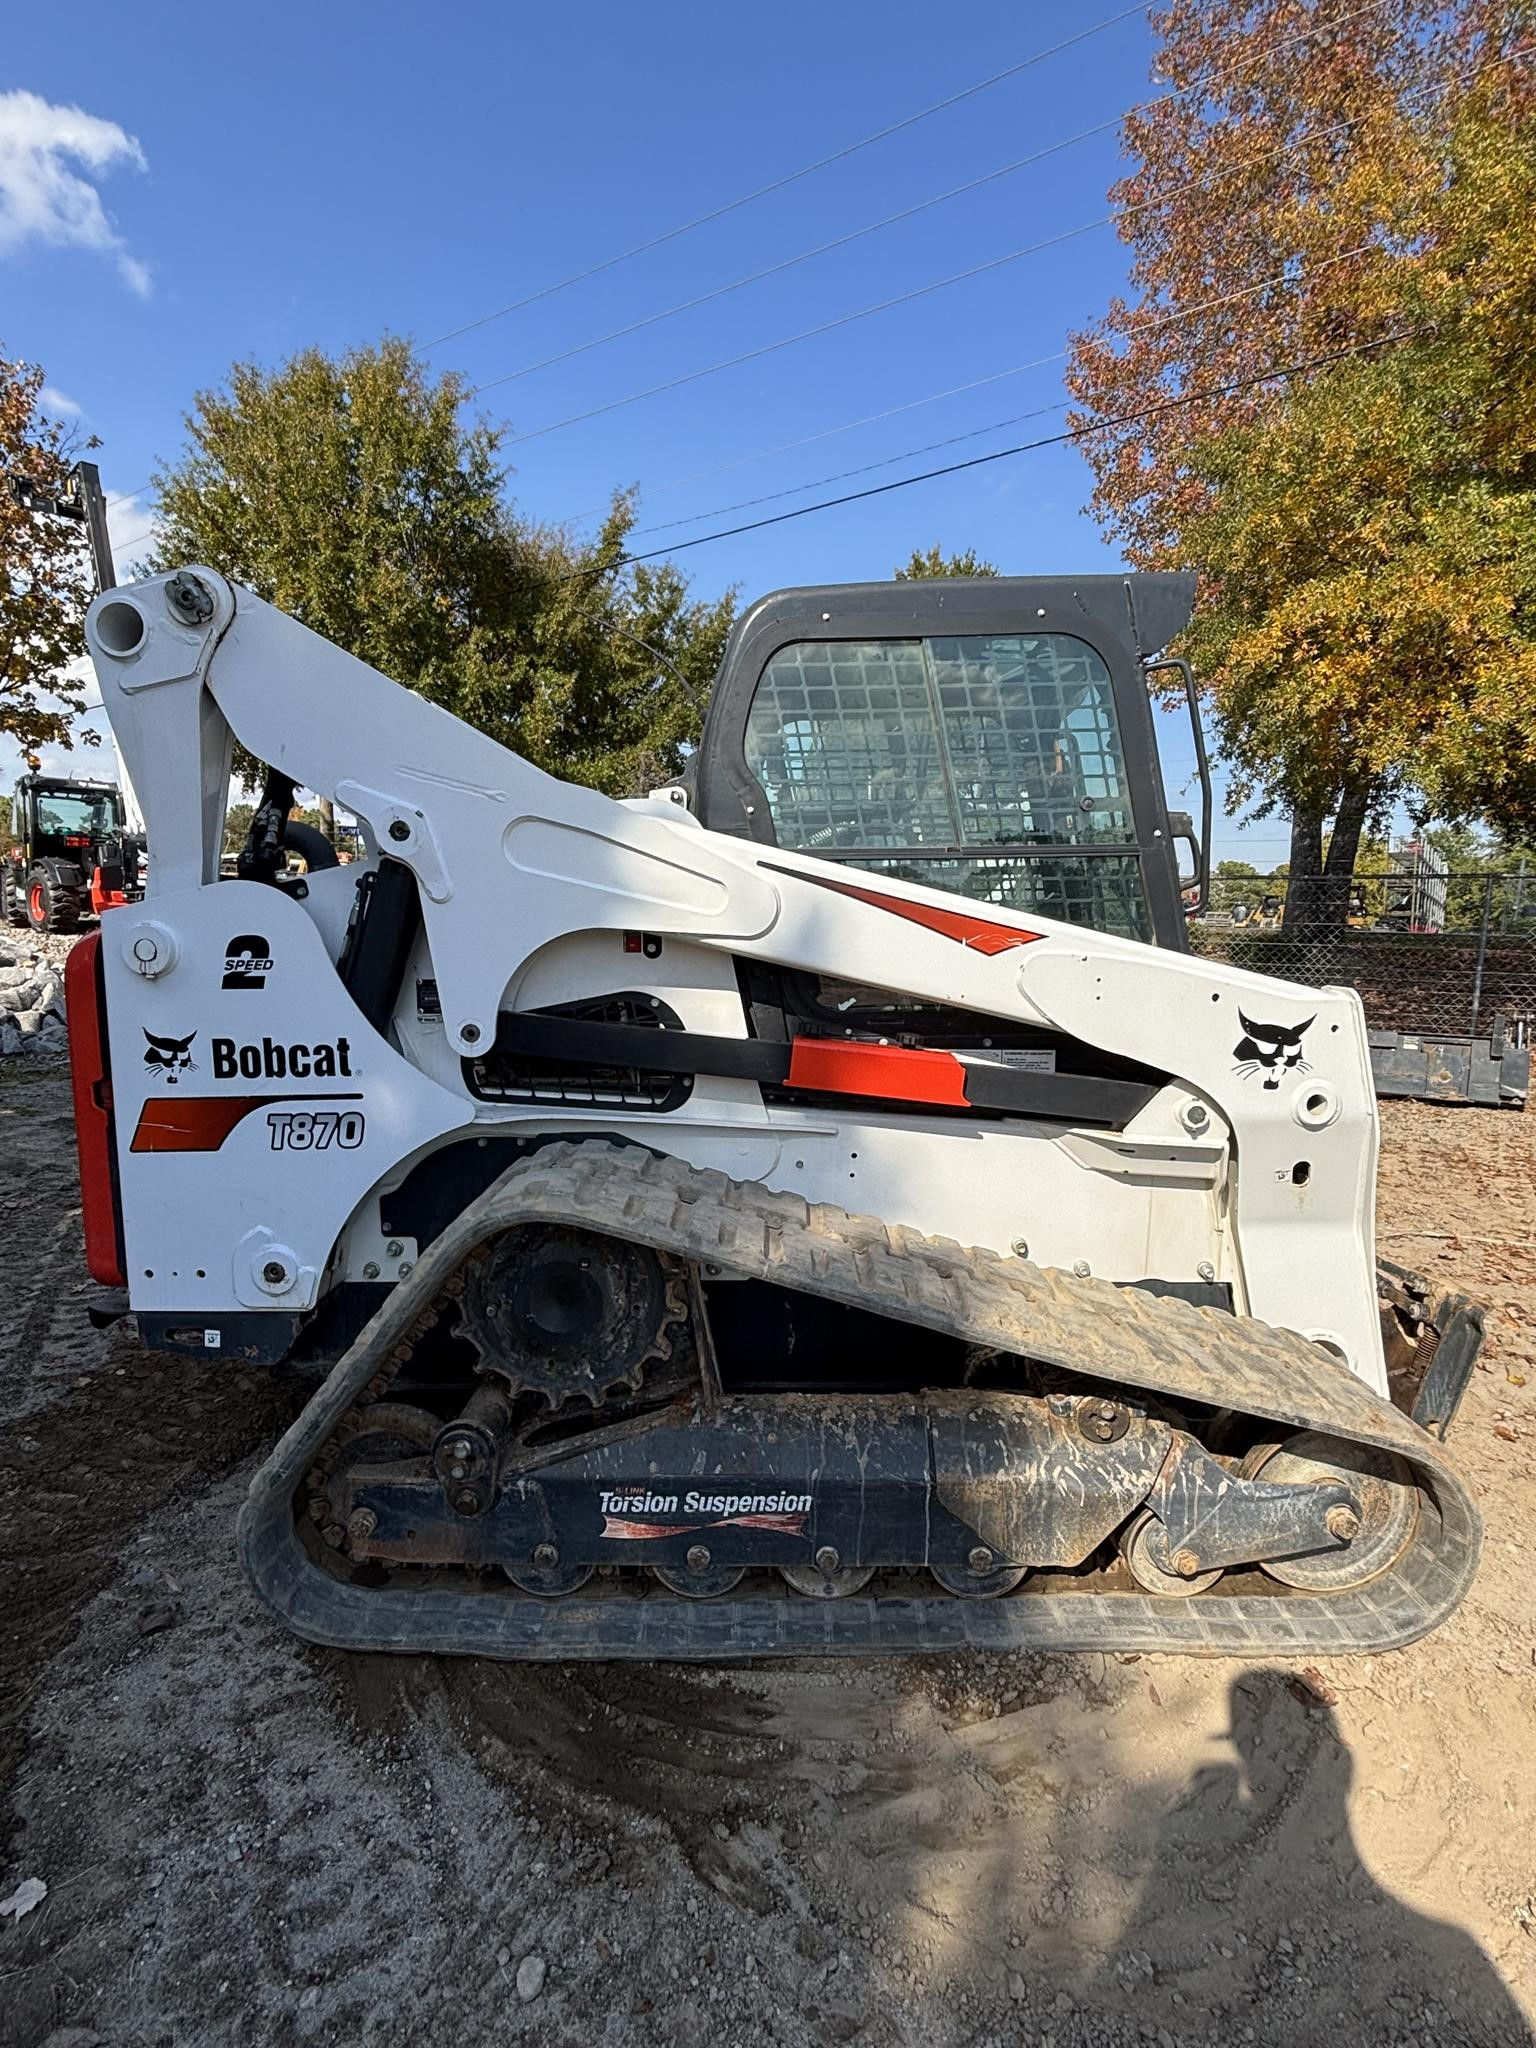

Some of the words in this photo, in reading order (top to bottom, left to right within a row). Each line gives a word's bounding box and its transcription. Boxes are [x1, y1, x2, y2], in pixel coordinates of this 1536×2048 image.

[221, 934, 270, 989] 2
[224, 959, 273, 971] SPEED
[211, 1037, 352, 1079] Bobcat
[267, 1111, 365, 1150] T870
[599, 1491, 679, 1513] Torsion
[684, 1491, 812, 1517] Suspension
